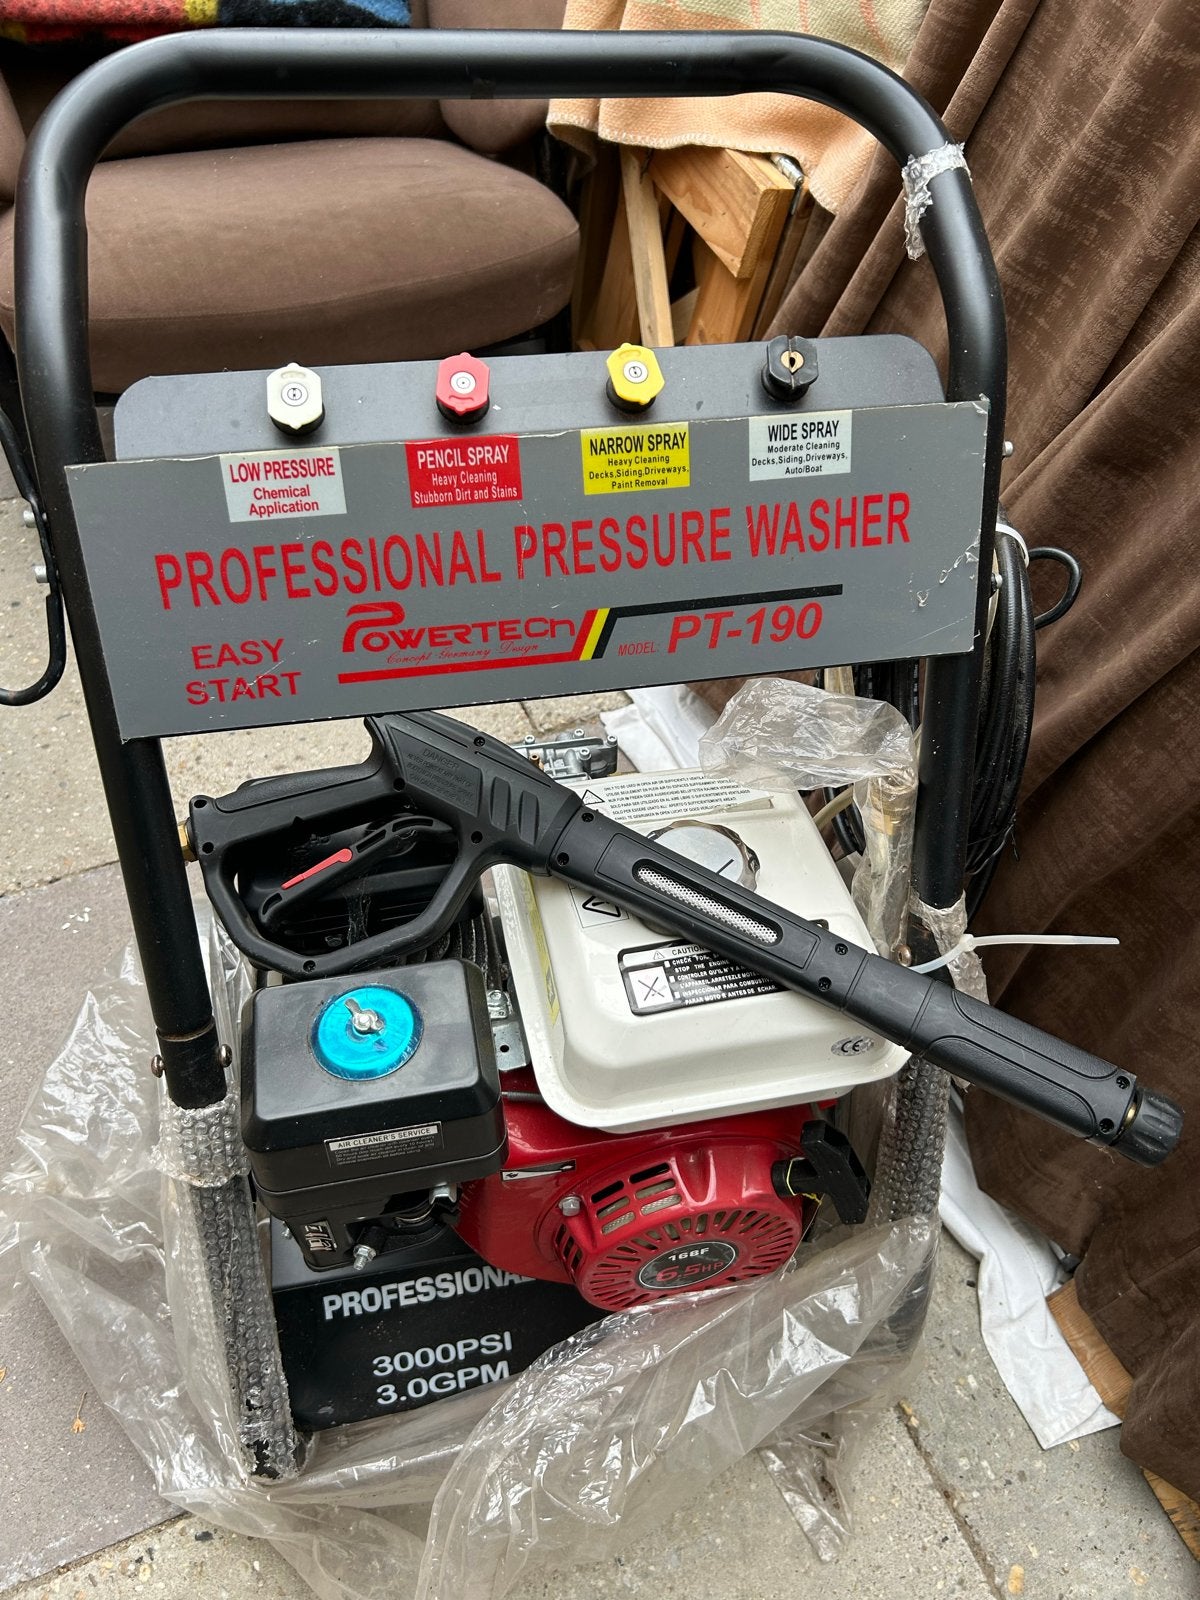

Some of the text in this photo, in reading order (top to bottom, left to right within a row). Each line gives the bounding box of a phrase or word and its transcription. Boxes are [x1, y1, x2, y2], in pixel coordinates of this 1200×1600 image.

[768, 420, 839, 442] WIDE SPRAY
[590, 432, 687, 456] NARROW SPRAY
[768, 441, 840, 453] Moderate Cleaning
[417, 444, 509, 469] PENCIL SPRAY
[608, 455, 670, 467] Heavy Cleaning
[229, 457, 335, 483] LOW PRESSURE
[432, 469, 498, 487] Heavy Cleaning
[785, 464, 822, 475] Auto/Boat
[253, 484, 311, 500] Chemical
[612, 477, 668, 490] Paint Removal
[414, 485, 518, 504] Stubborn Dirt and Stains
[249, 500, 319, 518] Application
[154, 492, 911, 610] PROFESSIONAL PRESSURE WASHER
[667, 602, 823, 654] PT-190
[191, 637, 285, 670] EASY
[386, 640, 539, 666] Concept Germany Design
[185, 671, 302, 705] START
[422, 748, 460, 770] DANGER
[672, 956, 692, 966] CHECK
[674, 965, 690, 973] STOP
[677, 971, 707, 981] CONTROLER
[723, 982, 739, 990] PARA
[840, 1039, 864, 1053] CE
[353, 1134, 396, 1146] CLEANER'S
[397, 1127, 432, 1139] SERVICE
[668, 1247, 710, 1261] 168F
[322, 1265, 536, 1320] PROFESSIONA
[372, 1331, 513, 1377] 3000PSI
[376, 1360, 511, 1406] 3.0GPM
